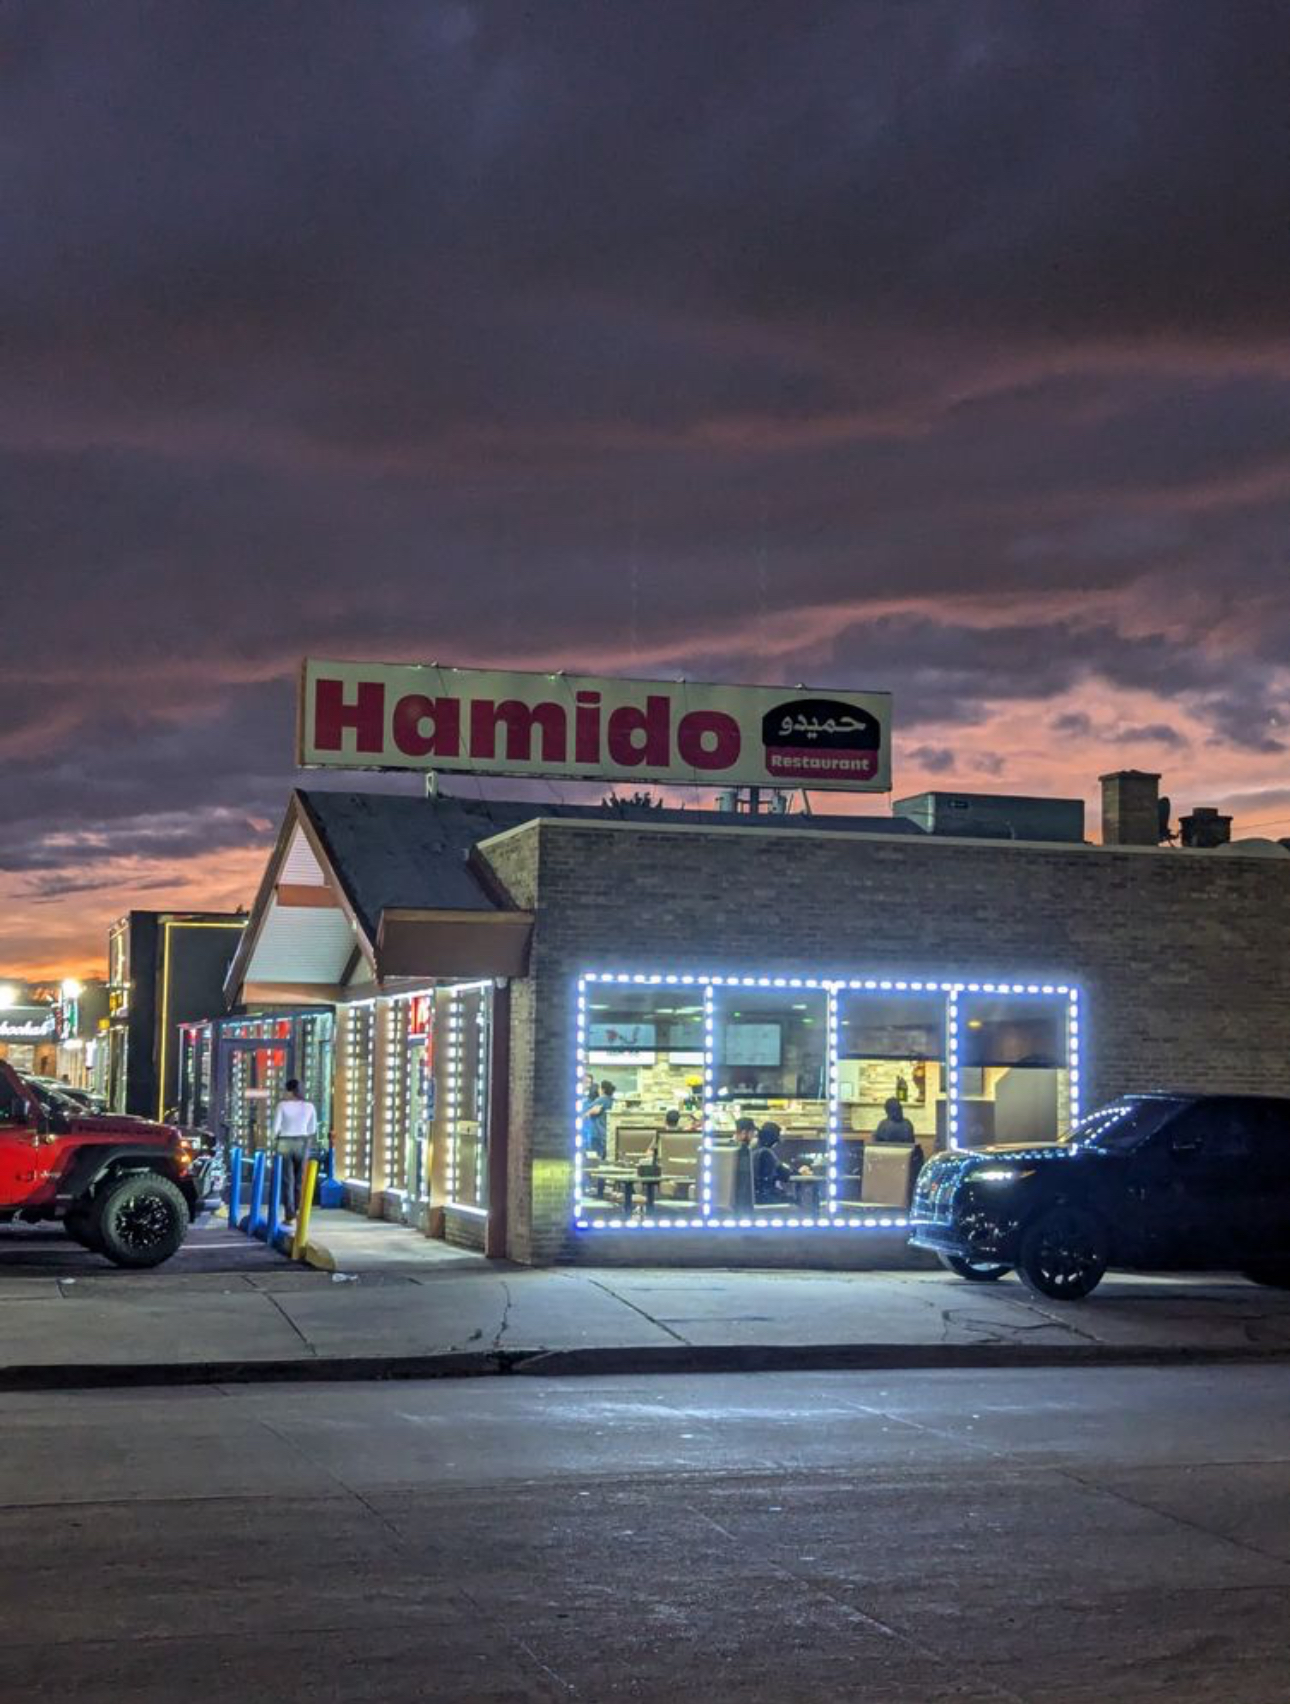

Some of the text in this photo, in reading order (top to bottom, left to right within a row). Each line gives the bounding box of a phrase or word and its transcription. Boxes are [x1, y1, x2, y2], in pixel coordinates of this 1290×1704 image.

[314, 678, 741, 770] Hamido
[778, 714, 867, 739] حميدو
[771, 755, 870, 771] Restaurant
